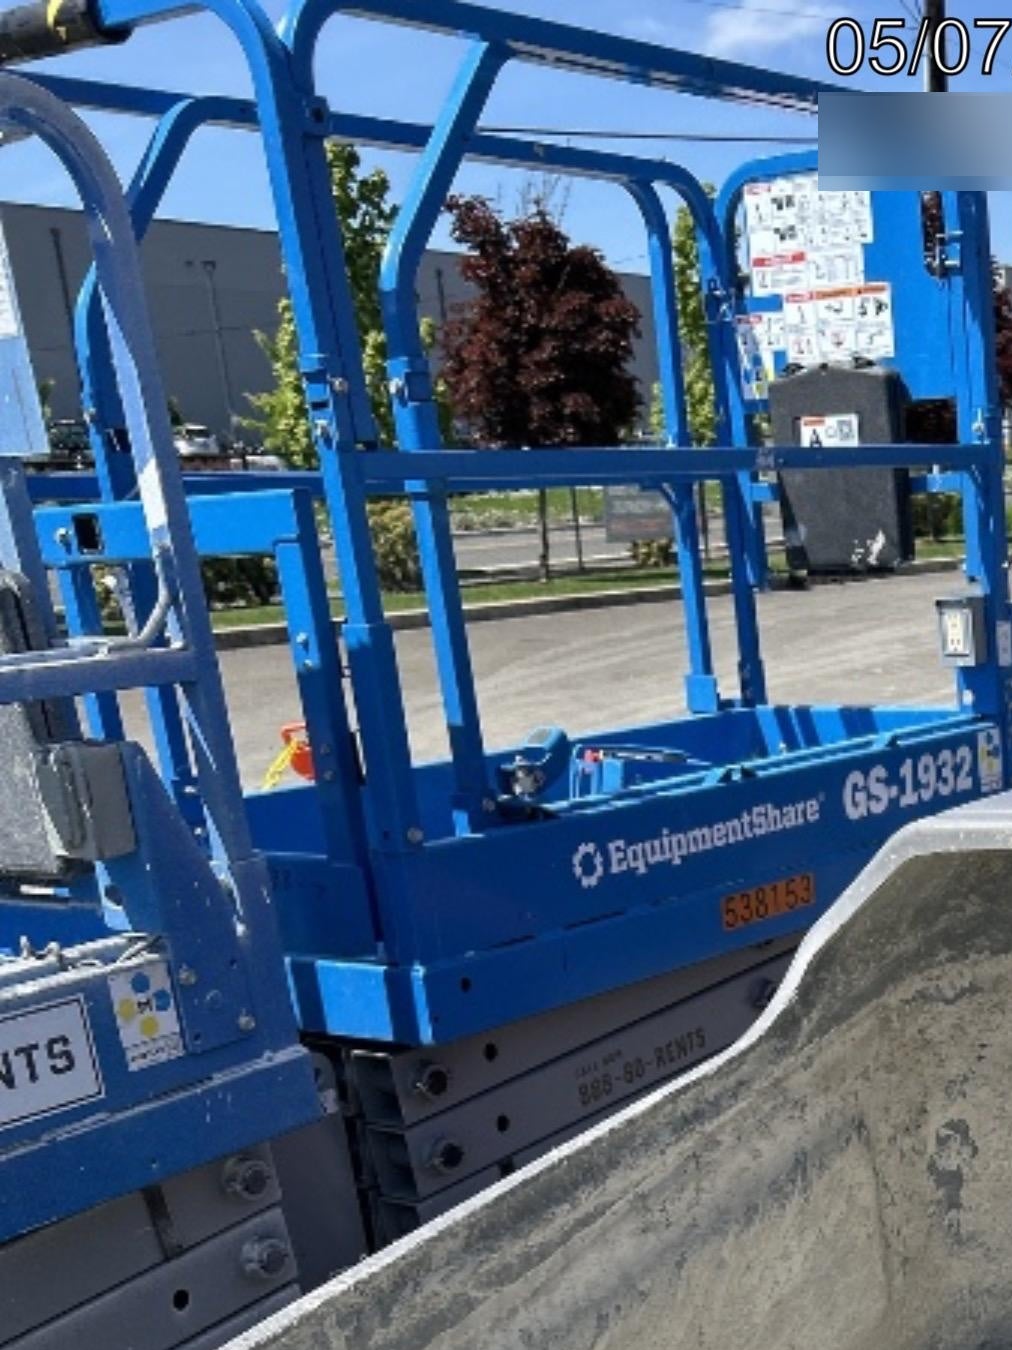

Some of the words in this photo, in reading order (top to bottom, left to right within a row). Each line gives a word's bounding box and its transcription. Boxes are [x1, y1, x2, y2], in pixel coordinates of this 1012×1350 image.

[843, 746, 973, 820] GS-1932
[608, 801, 821, 875] EquipmentShare
[723, 875, 813, 928] 538153
